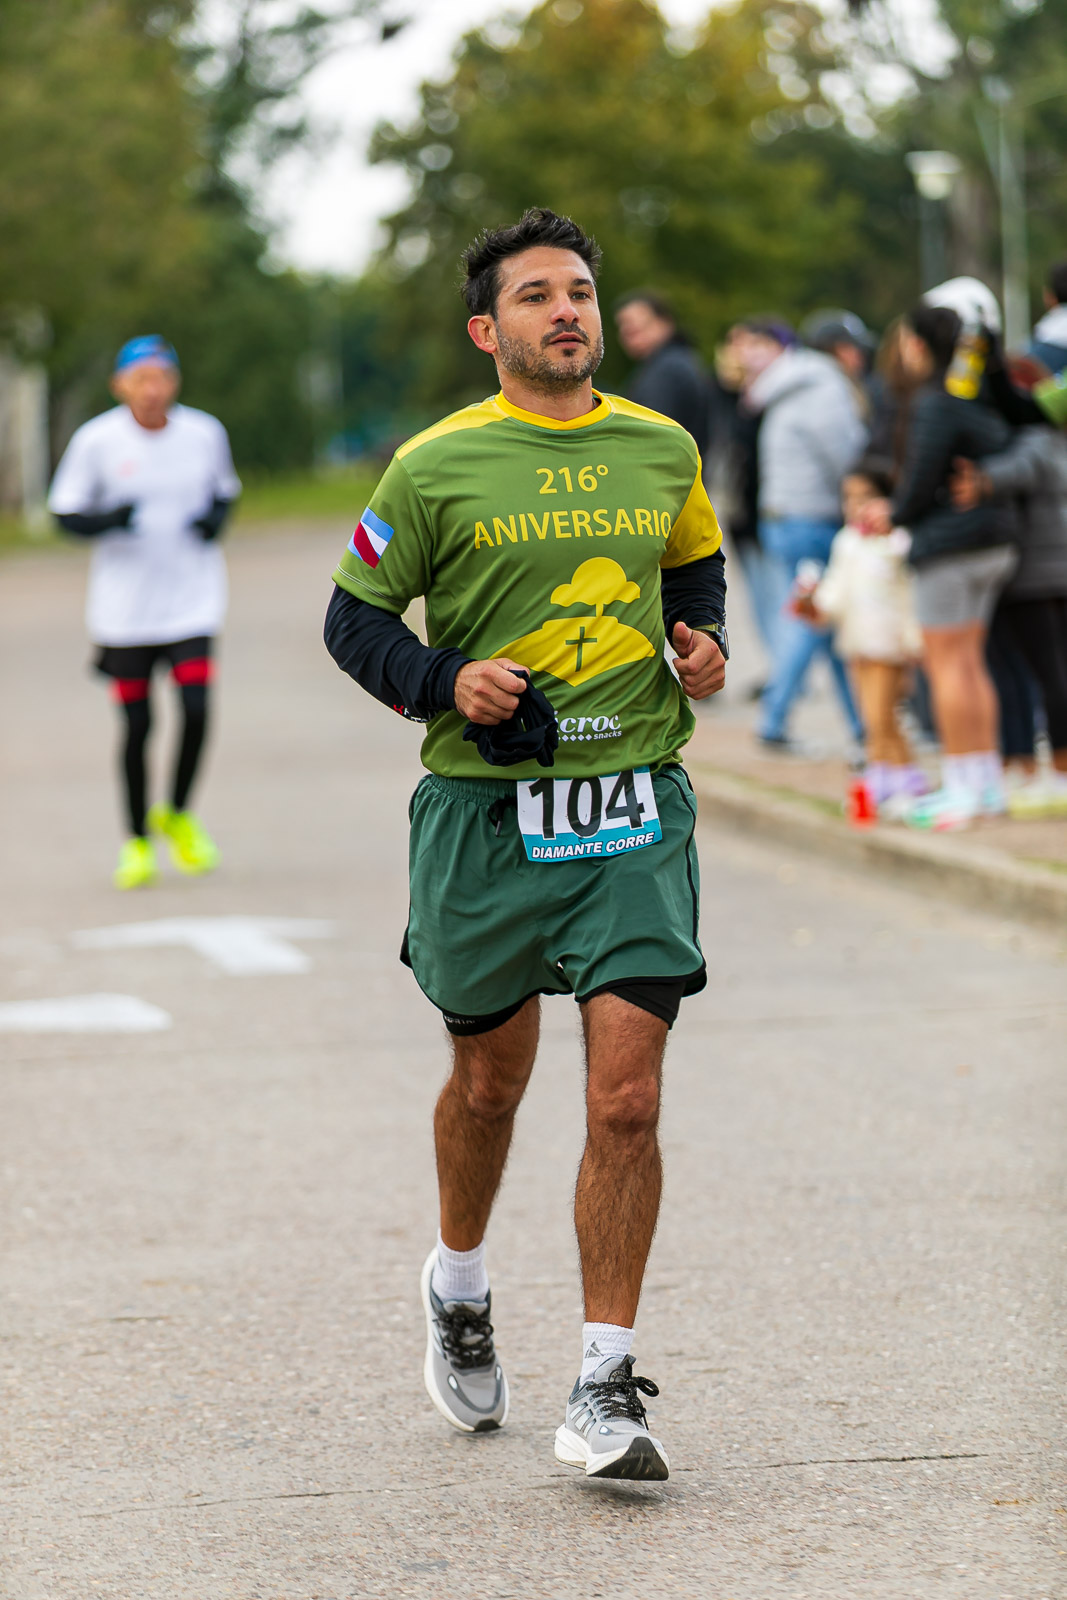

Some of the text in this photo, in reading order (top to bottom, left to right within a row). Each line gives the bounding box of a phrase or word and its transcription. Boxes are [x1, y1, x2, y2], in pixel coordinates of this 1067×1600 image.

[536, 464, 609, 494] 216°
[474, 509, 671, 549] ANIVERSARIO
[593, 731, 622, 740] snacks
[528, 769, 645, 840] 104
[532, 832, 654, 859] DIAMANTE CORRE
